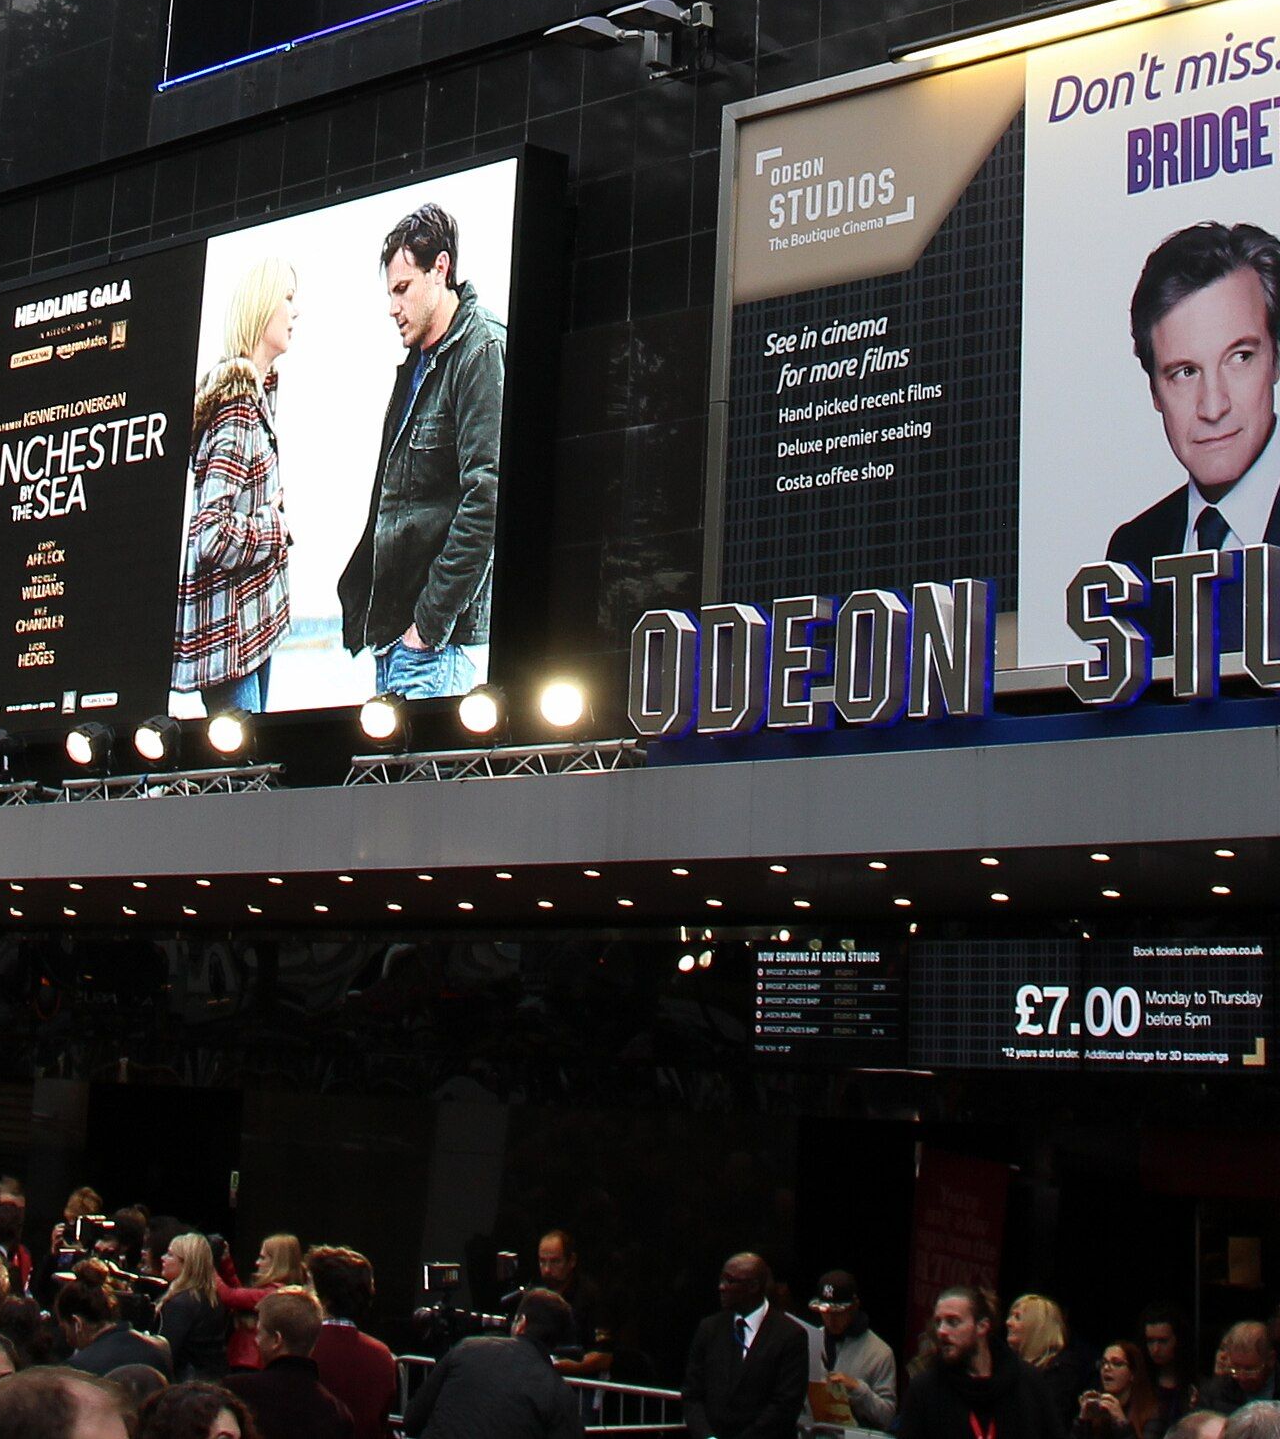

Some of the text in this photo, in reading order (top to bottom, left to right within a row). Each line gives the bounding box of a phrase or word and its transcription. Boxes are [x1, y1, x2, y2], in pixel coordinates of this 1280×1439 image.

[1048, 52, 1165, 123] Don't
[770, 157, 824, 187] ODEON
[768, 167, 896, 230] STUDIOS
[768, 215, 885, 252] The Boutique Cinema
[14, 279, 132, 328] HEADLINE GALA
[764, 316, 888, 358] See in cinema
[776, 344, 910, 395] for more films
[22, 403, 70, 428] KENNETH
[70, 392, 127, 419] LONERGAN
[778, 382, 943, 424] Hand picked recent films
[777, 419, 932, 458] Deluxe premier seating
[19, 483, 35, 503] BY
[776, 461, 895, 493] Costa coffee shop
[10, 474, 88, 524] THE SEA
[26, 550, 65, 568] AFFLECK
[21, 581, 65, 601] WILLIAMS
[15, 614, 65, 634] CHANDLER
[17, 650, 56, 668] HEDGES
[629, 577, 993, 739] ODEON
[757, 951, 881, 963] NOW SHOWING AT ODEON STUDIOS
[1133, 944, 1263, 957] Book tickets online odeon.co.uk
[1014, 984, 1142, 1038] £7.00
[1145, 989, 1263, 1009] Monday to Thursday
[1145, 1012, 1212, 1029] before 5pm
[1015, 1048, 1039, 1060] years
[1038, 1047, 1054, 1059] and
[1083, 1049, 1125, 1061] Additional
[1125, 1050, 1154, 1063] charge
[1155, 1049, 1168, 1061] for
[1168, 1050, 1182, 1061] 3D
[1182, 1051, 1229, 1064] screenings
